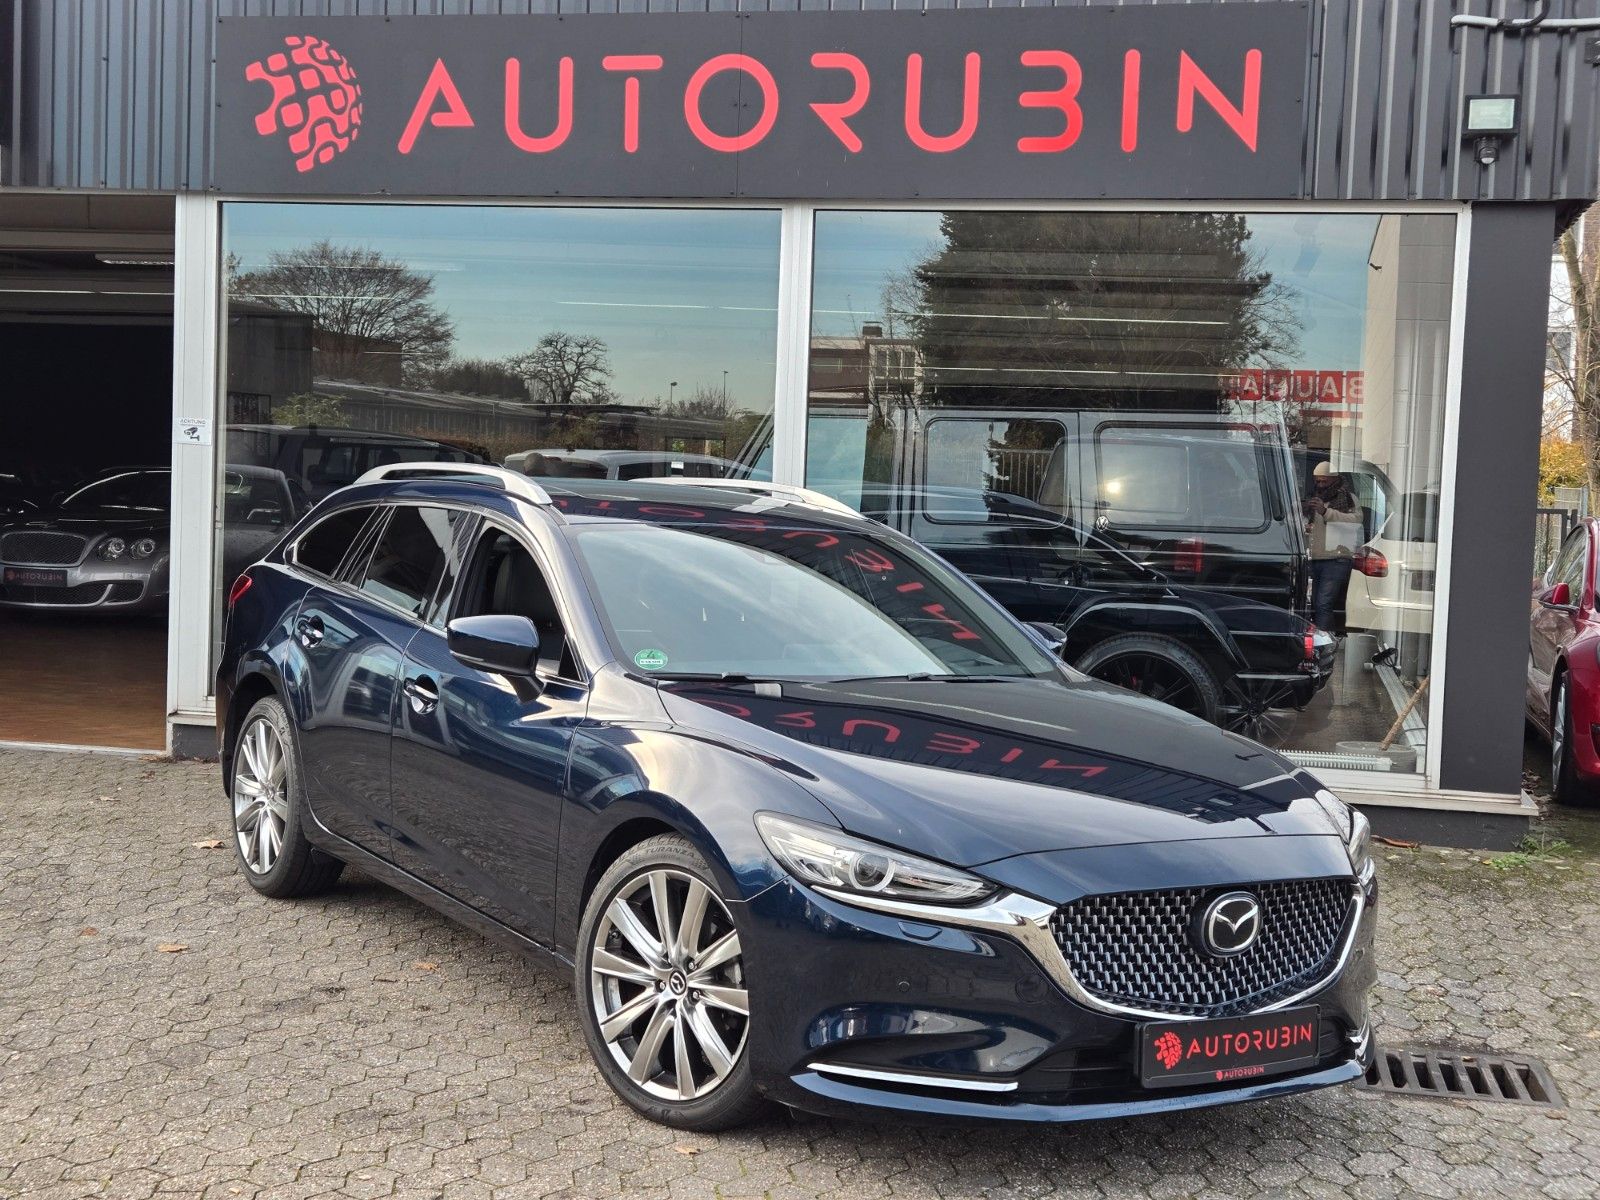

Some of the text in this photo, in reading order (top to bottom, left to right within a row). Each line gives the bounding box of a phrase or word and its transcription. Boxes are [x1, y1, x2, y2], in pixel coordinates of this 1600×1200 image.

[396, 47, 1263, 155] AUTORUBIN
[179, 418, 206, 426] ACHTUNG
[15, 571, 64, 580] AUTORUBIN
[646, 846, 695, 858] TURANZA
[1186, 1022, 1312, 1060] AUTORUBIN
[1223, 1065, 1265, 1079] AUTORUBIN
